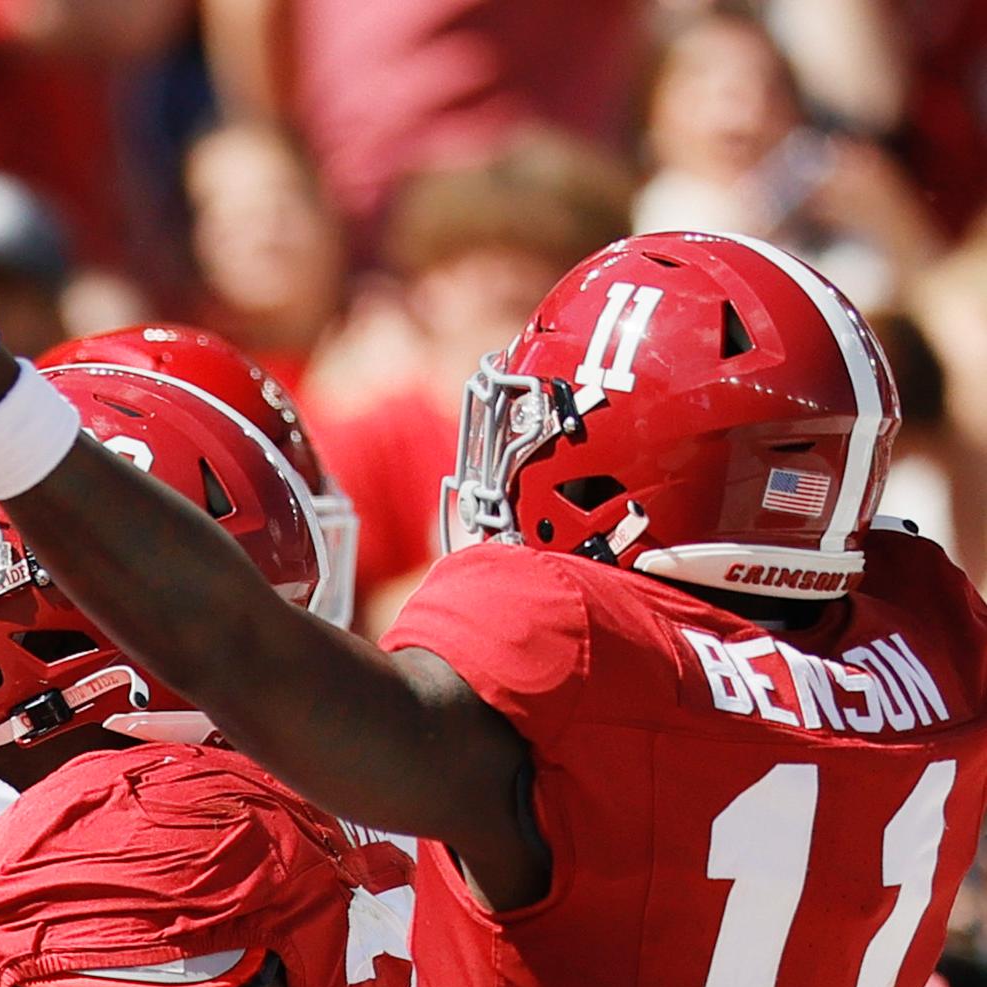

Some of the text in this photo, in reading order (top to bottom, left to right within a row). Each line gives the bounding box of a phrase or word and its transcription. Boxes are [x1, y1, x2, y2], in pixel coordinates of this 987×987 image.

[574, 281, 664, 393] 11
[724, 562, 844, 592] CRIMSON
[682, 633, 950, 733] BENSON
